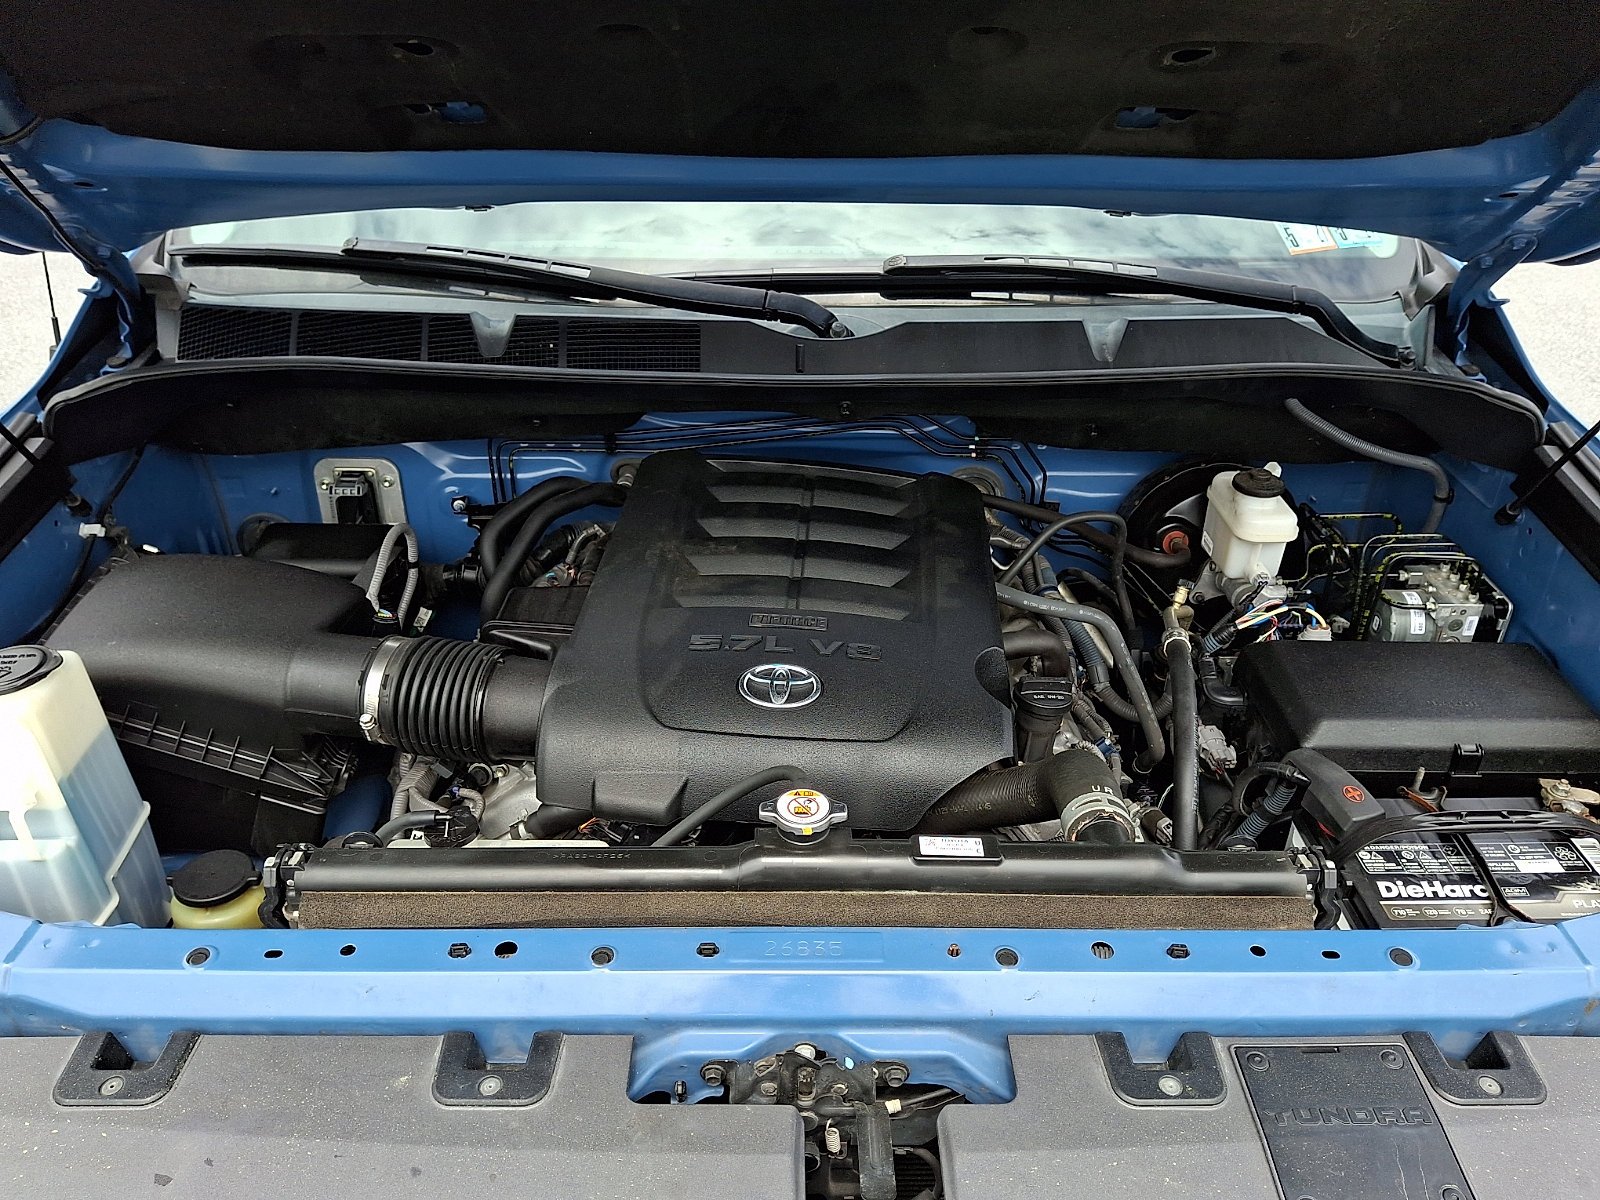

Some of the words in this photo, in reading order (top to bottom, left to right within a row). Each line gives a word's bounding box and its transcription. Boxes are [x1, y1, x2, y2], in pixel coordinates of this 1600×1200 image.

[688, 634, 795, 653] 5.7L
[809, 638, 882, 661] V8
[764, 940, 843, 957] 26835
[1264, 1105, 1434, 1127] TUNDRA
